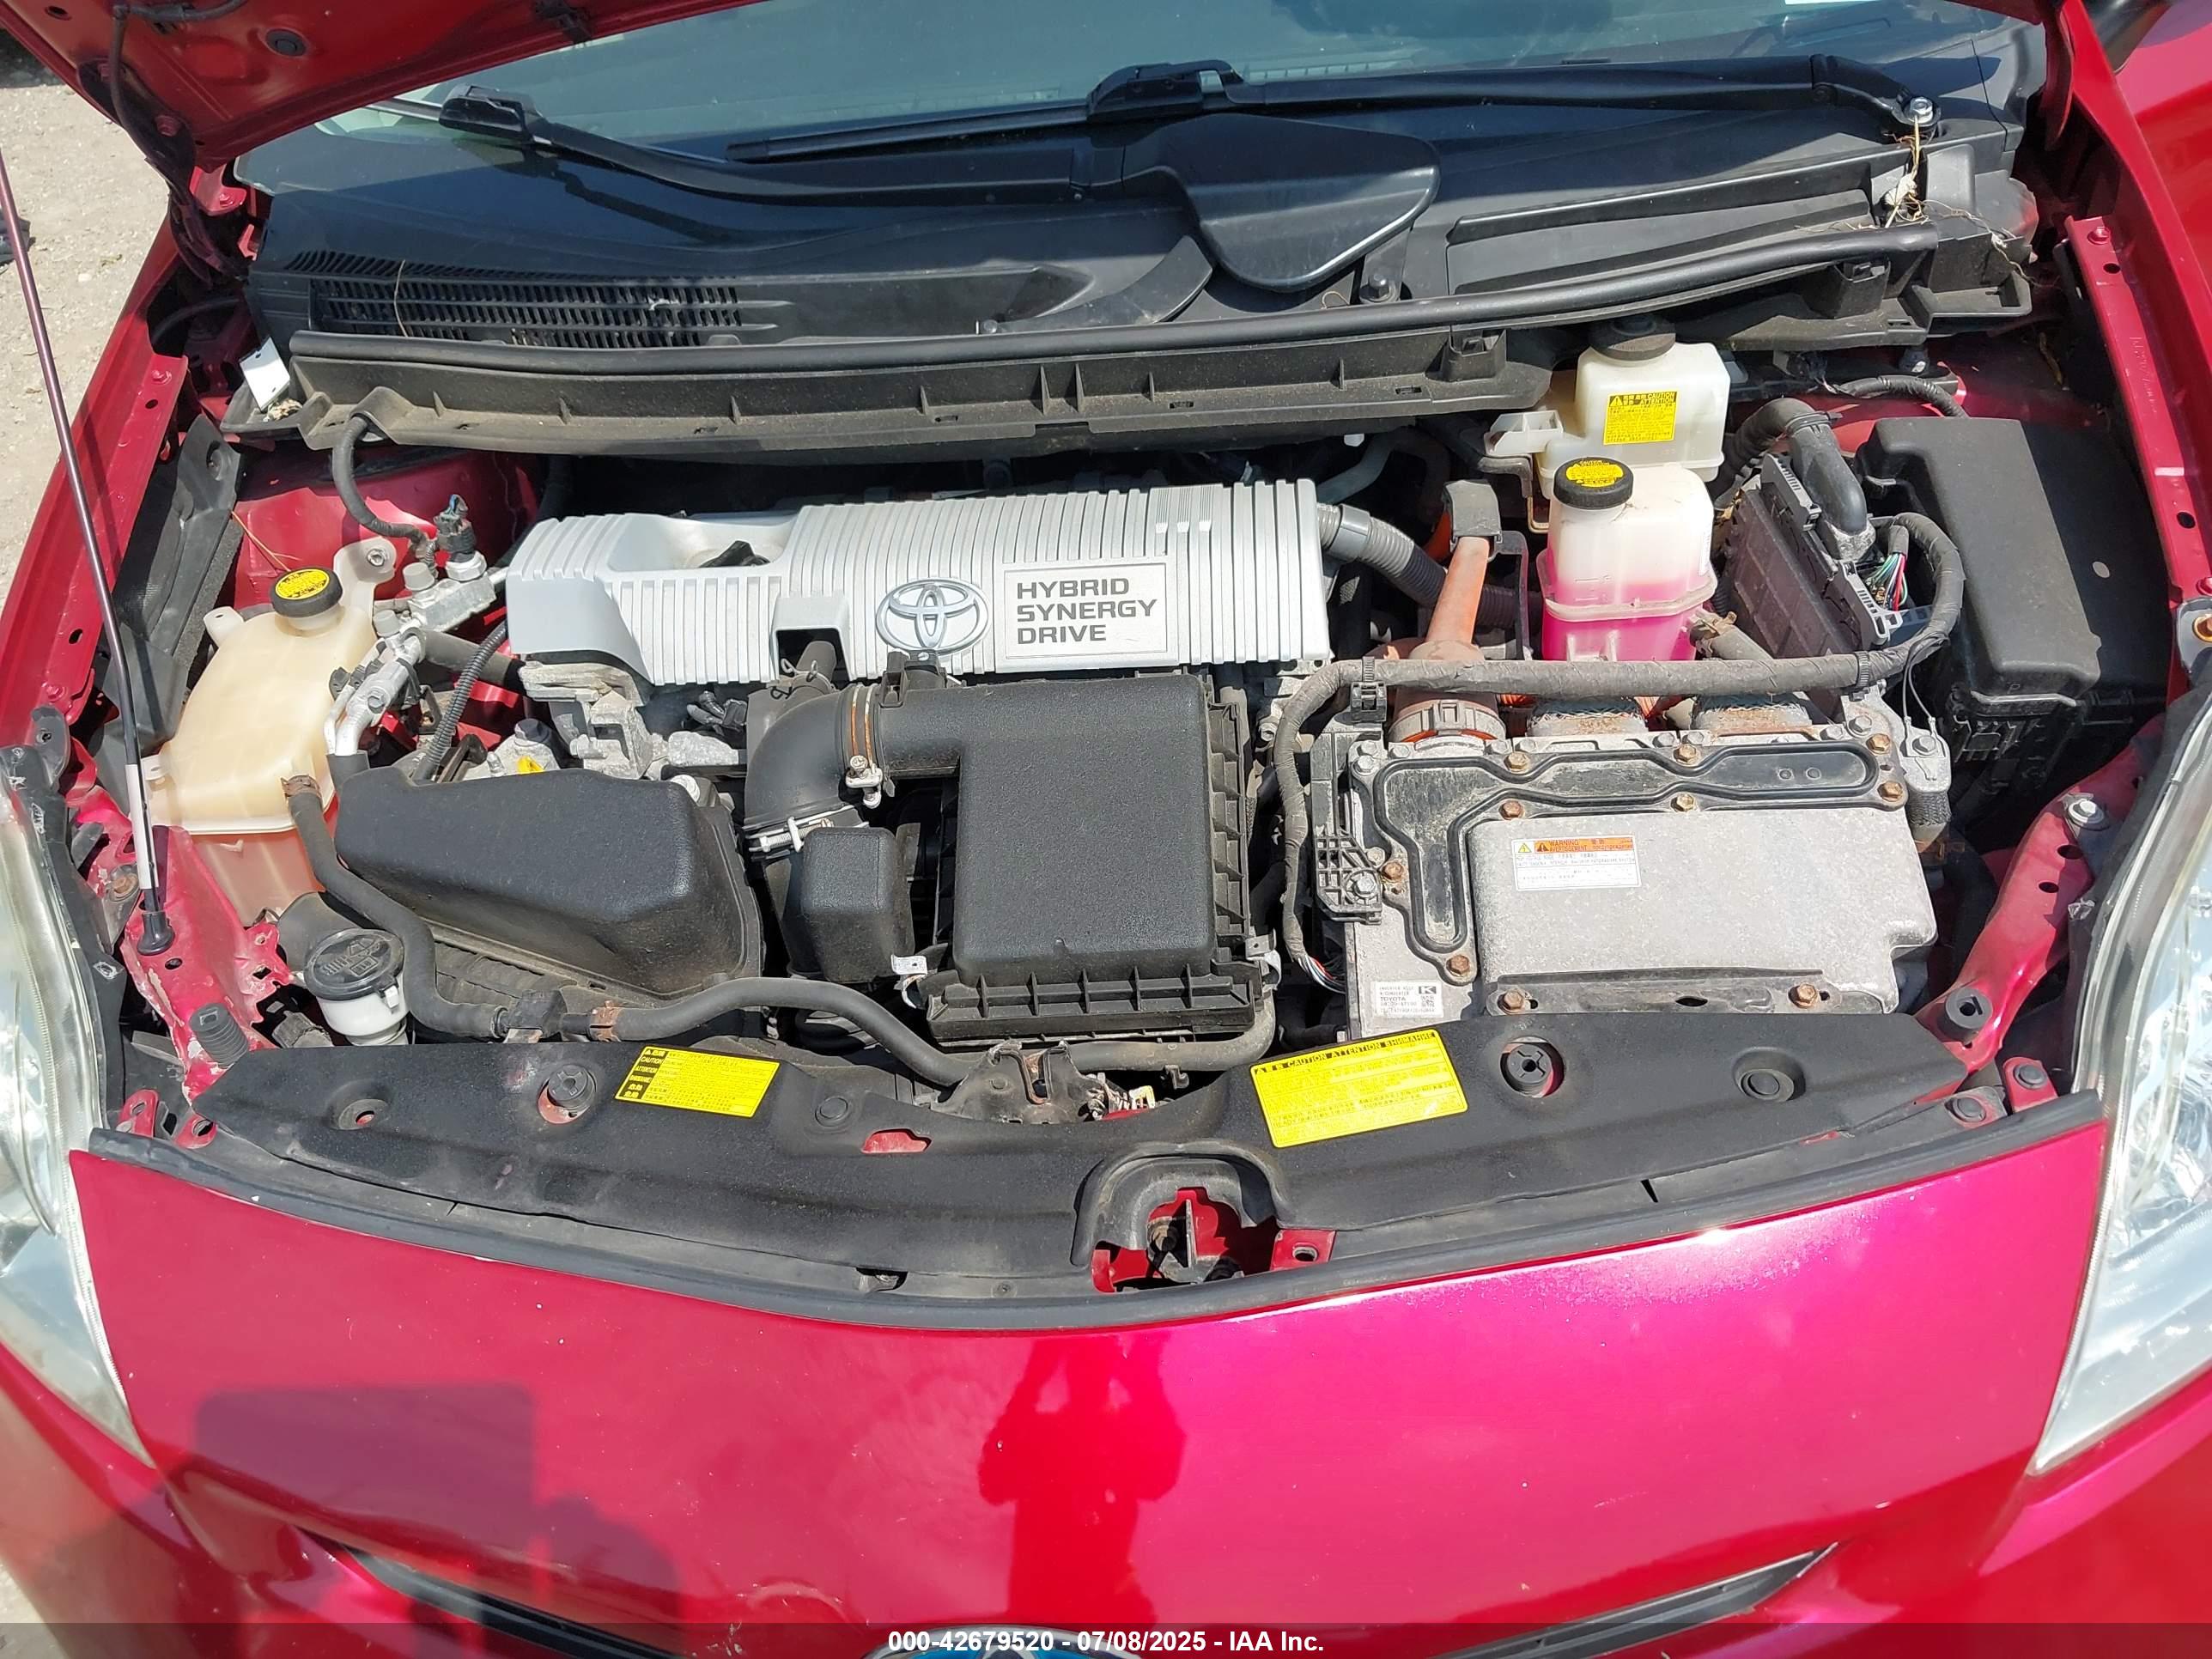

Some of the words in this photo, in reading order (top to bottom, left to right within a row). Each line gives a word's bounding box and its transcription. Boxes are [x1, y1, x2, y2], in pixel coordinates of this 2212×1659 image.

[1647, 392, 1675, 401] CAUTION
[1018, 578, 1129, 599] HYBRID
[1018, 599, 1157, 623] SYNERGY
[1018, 624, 1107, 644] DRIVE
[640, 1056, 664, 1065] CAUTION
[1288, 1052, 1327, 1067] CAUTION
[1333, 1042, 1382, 1058] ATTENTION
